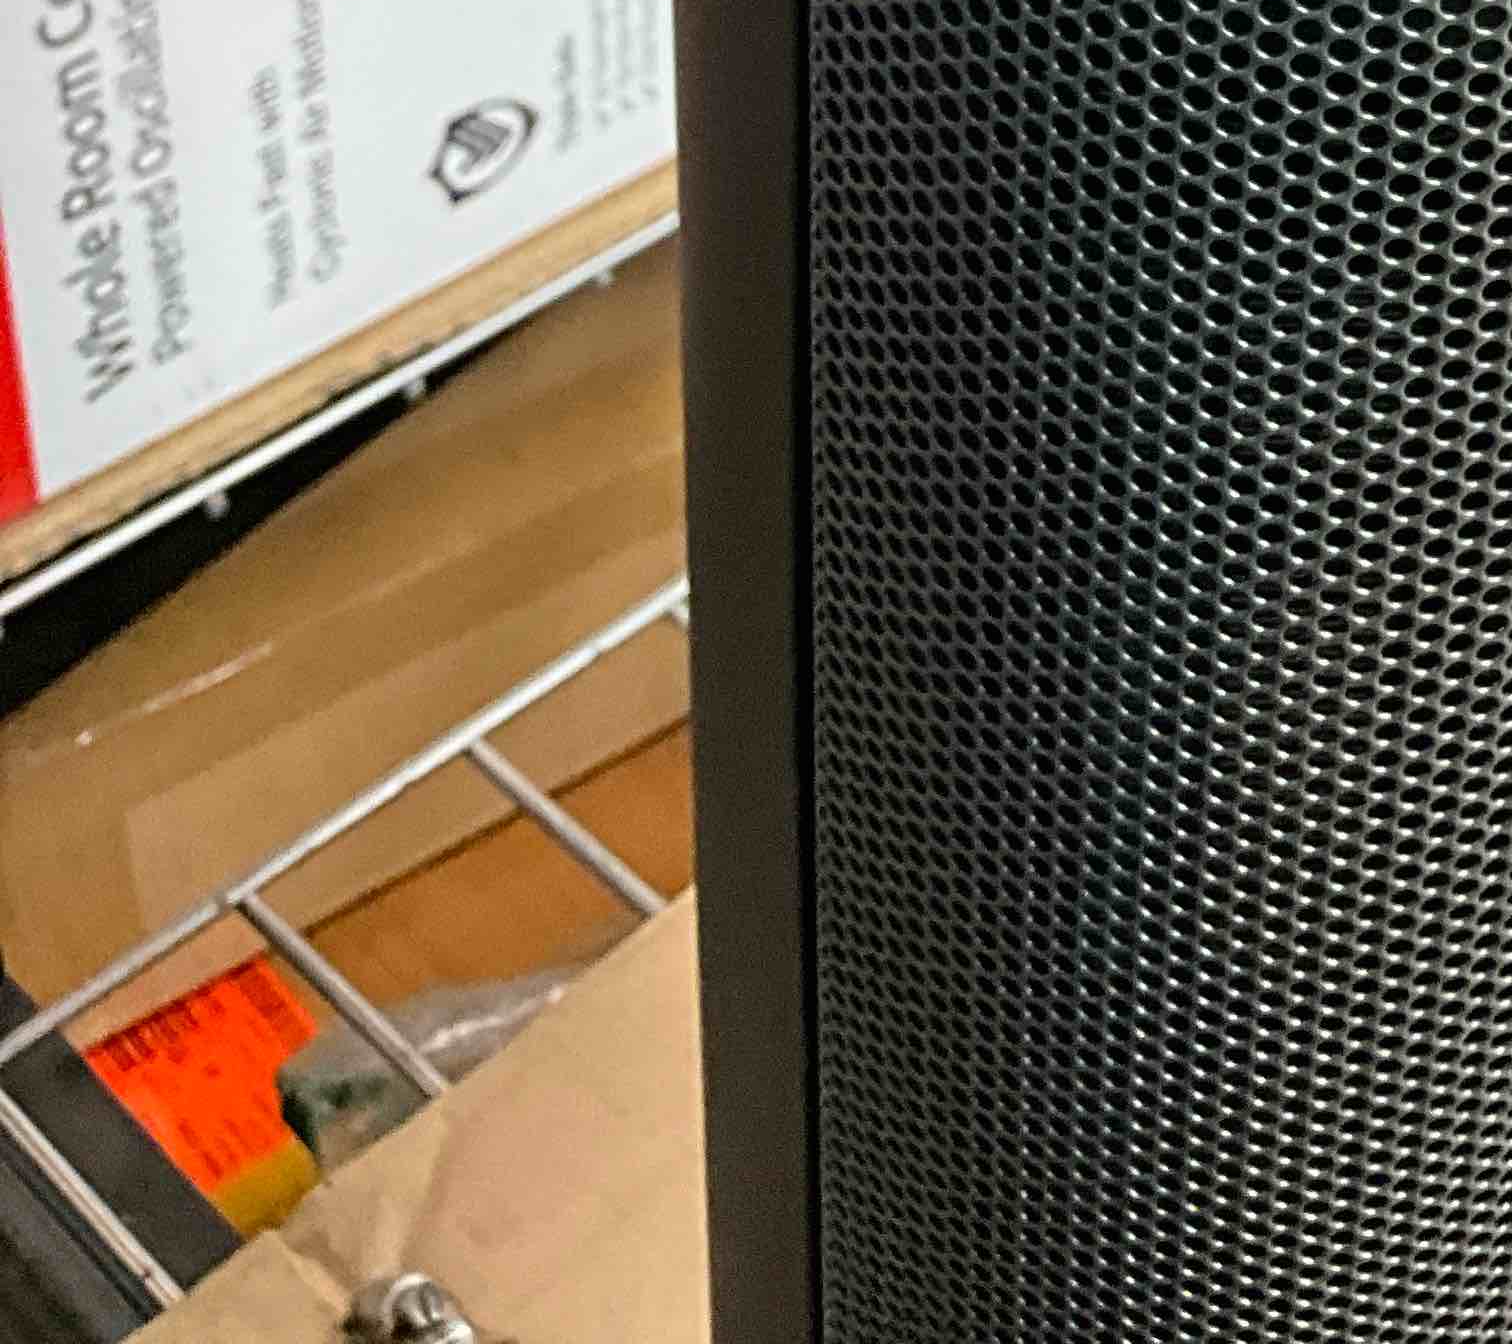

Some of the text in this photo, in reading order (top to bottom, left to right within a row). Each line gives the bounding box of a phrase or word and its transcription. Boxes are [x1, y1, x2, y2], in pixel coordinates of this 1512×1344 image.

[57, 47, 117, 221] Room
[61, 218, 136, 404] Whole
[128, 174, 193, 364] Powered
